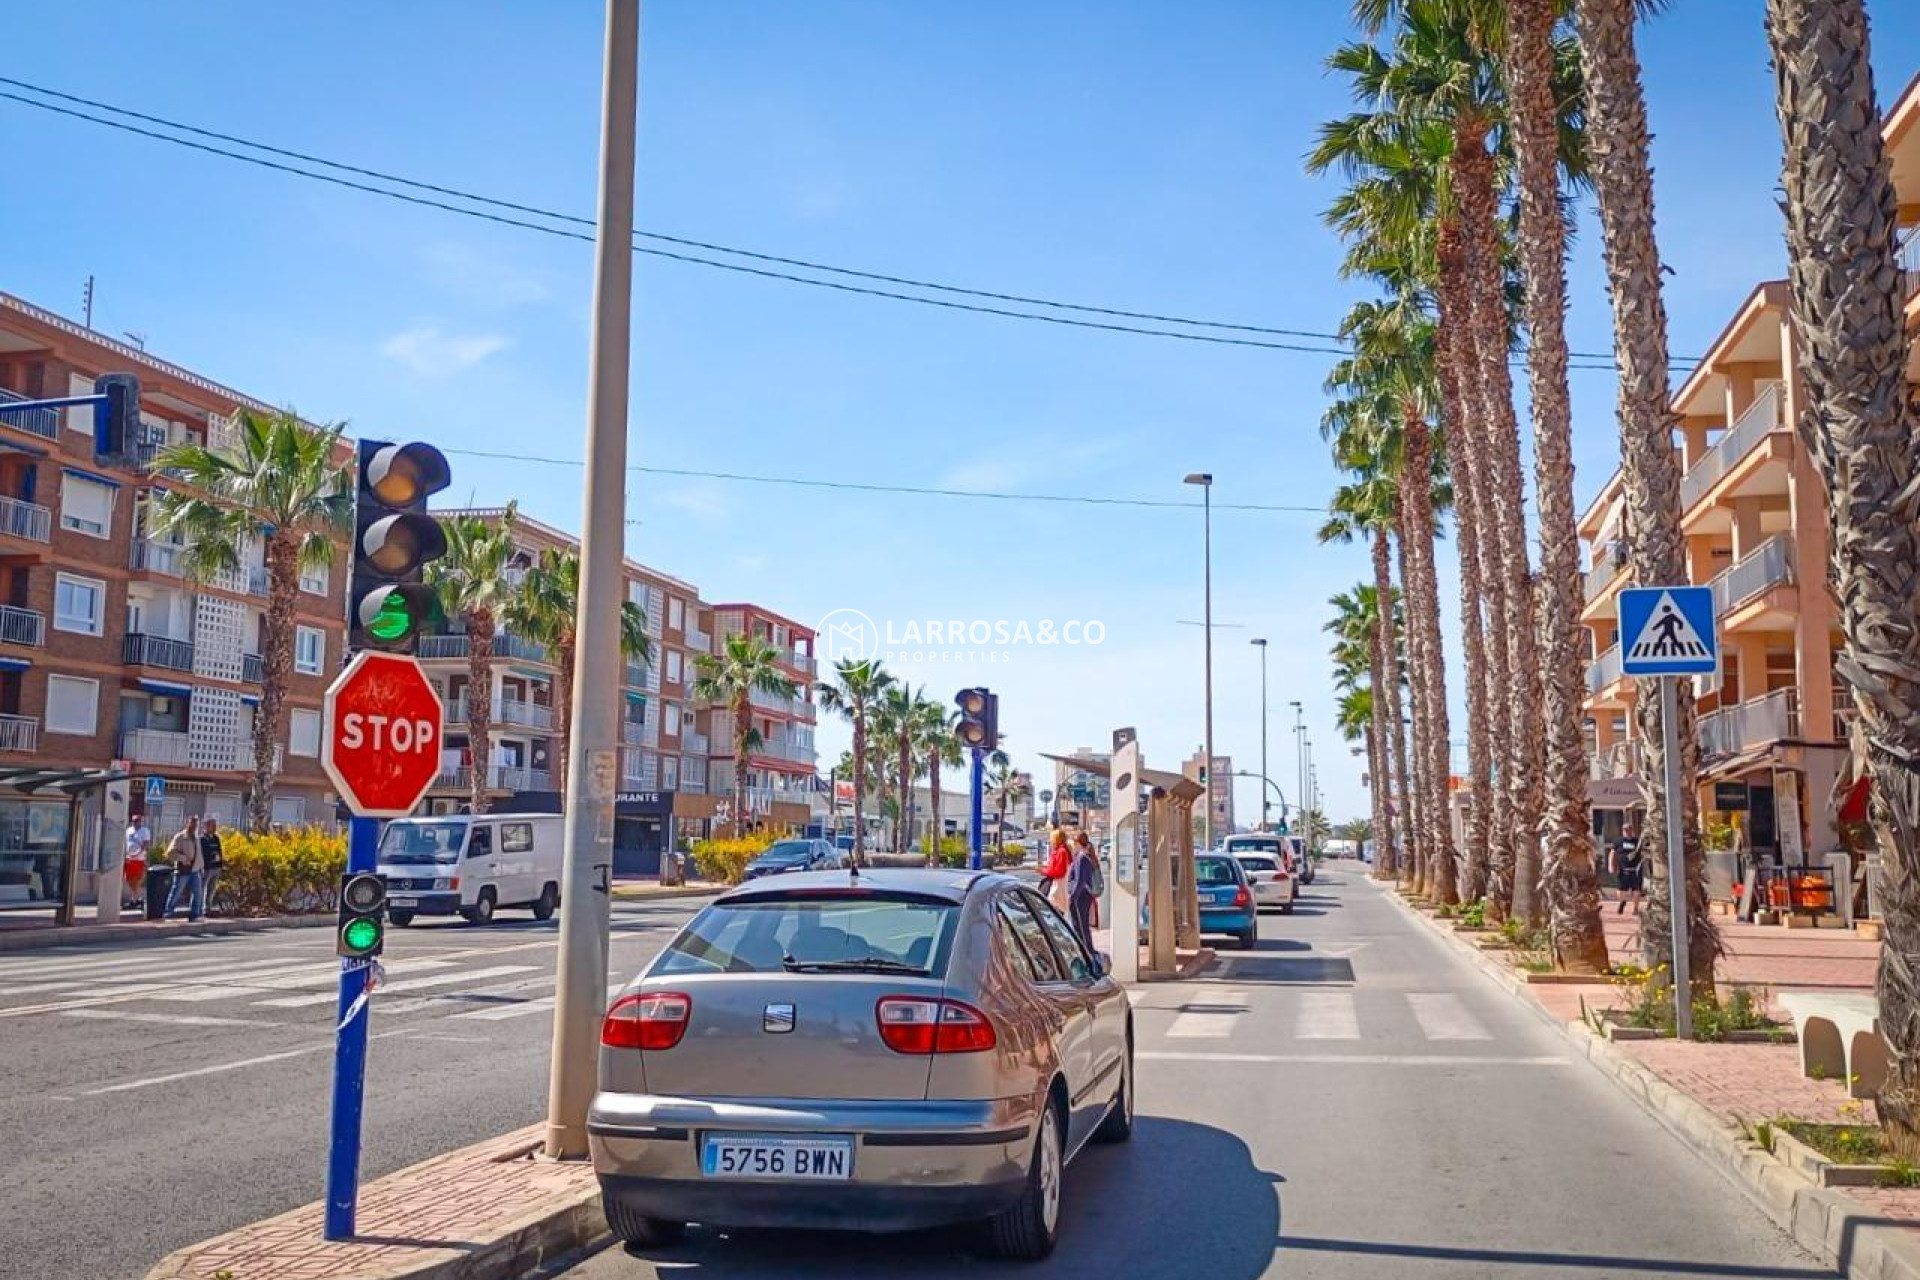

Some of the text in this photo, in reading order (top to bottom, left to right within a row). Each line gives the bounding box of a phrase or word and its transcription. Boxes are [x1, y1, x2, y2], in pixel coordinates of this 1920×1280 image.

[341, 713, 433, 754] STOP
[722, 1148, 843, 1175] 5756 BWN
